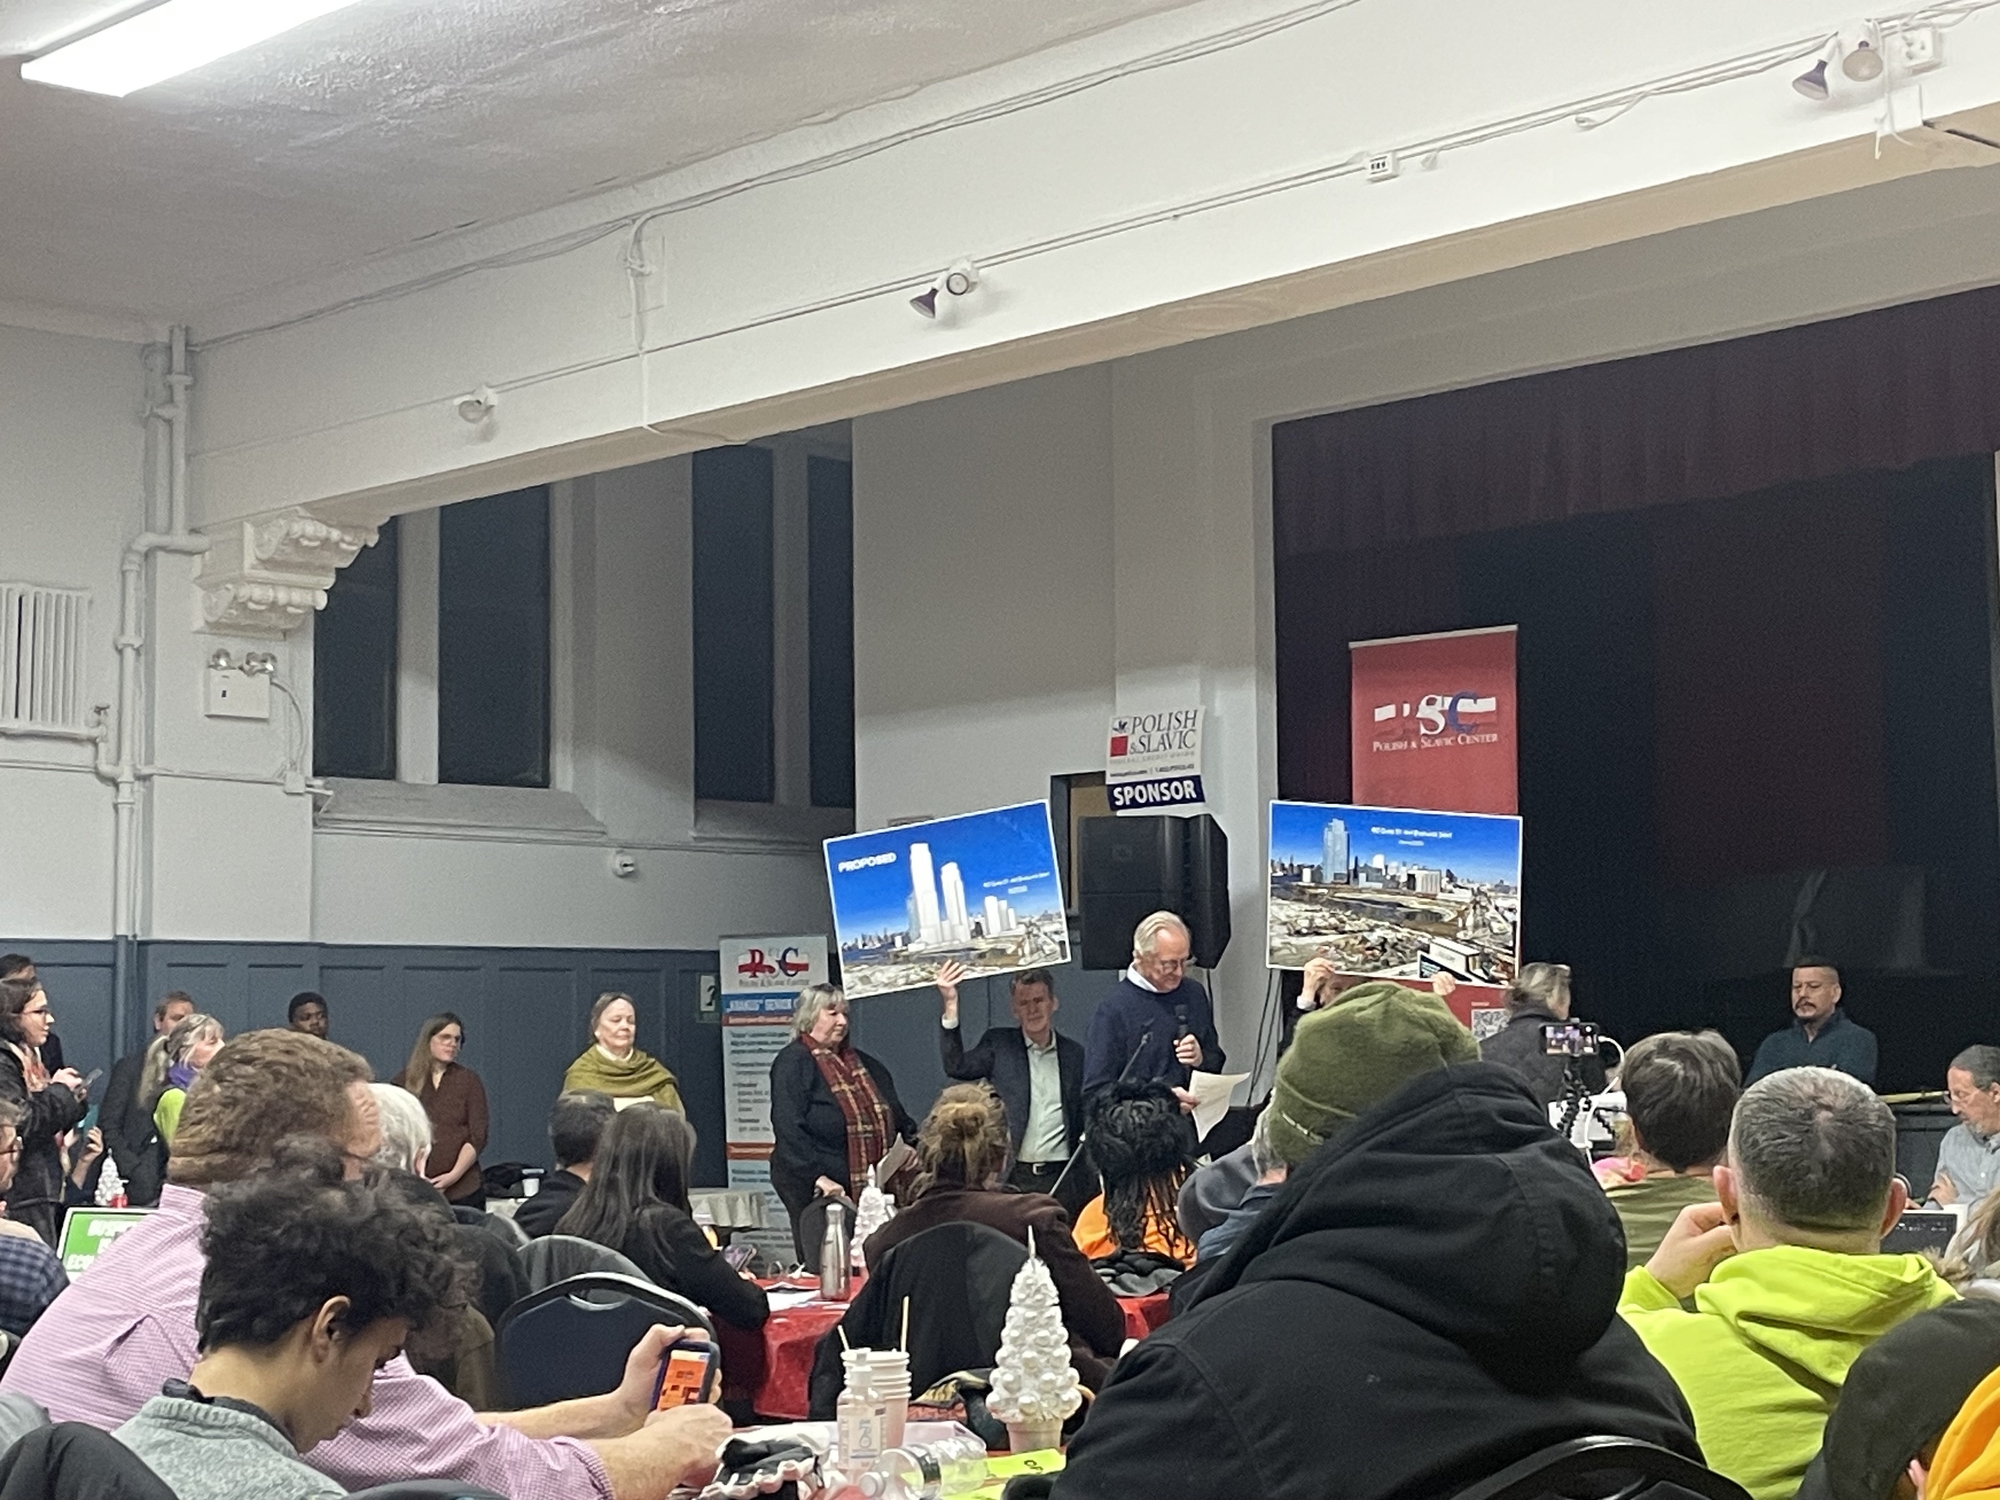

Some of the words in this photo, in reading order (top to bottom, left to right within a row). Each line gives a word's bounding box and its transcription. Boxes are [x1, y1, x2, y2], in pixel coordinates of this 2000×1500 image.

[1132, 709, 1198, 735] POLISH
[1136, 728, 1197, 754] SLAVIC
[1457, 733, 1498, 745] CENTER
[1112, 779, 1197, 806] SPONSOR
[838, 852, 897, 872] PROPOSED
